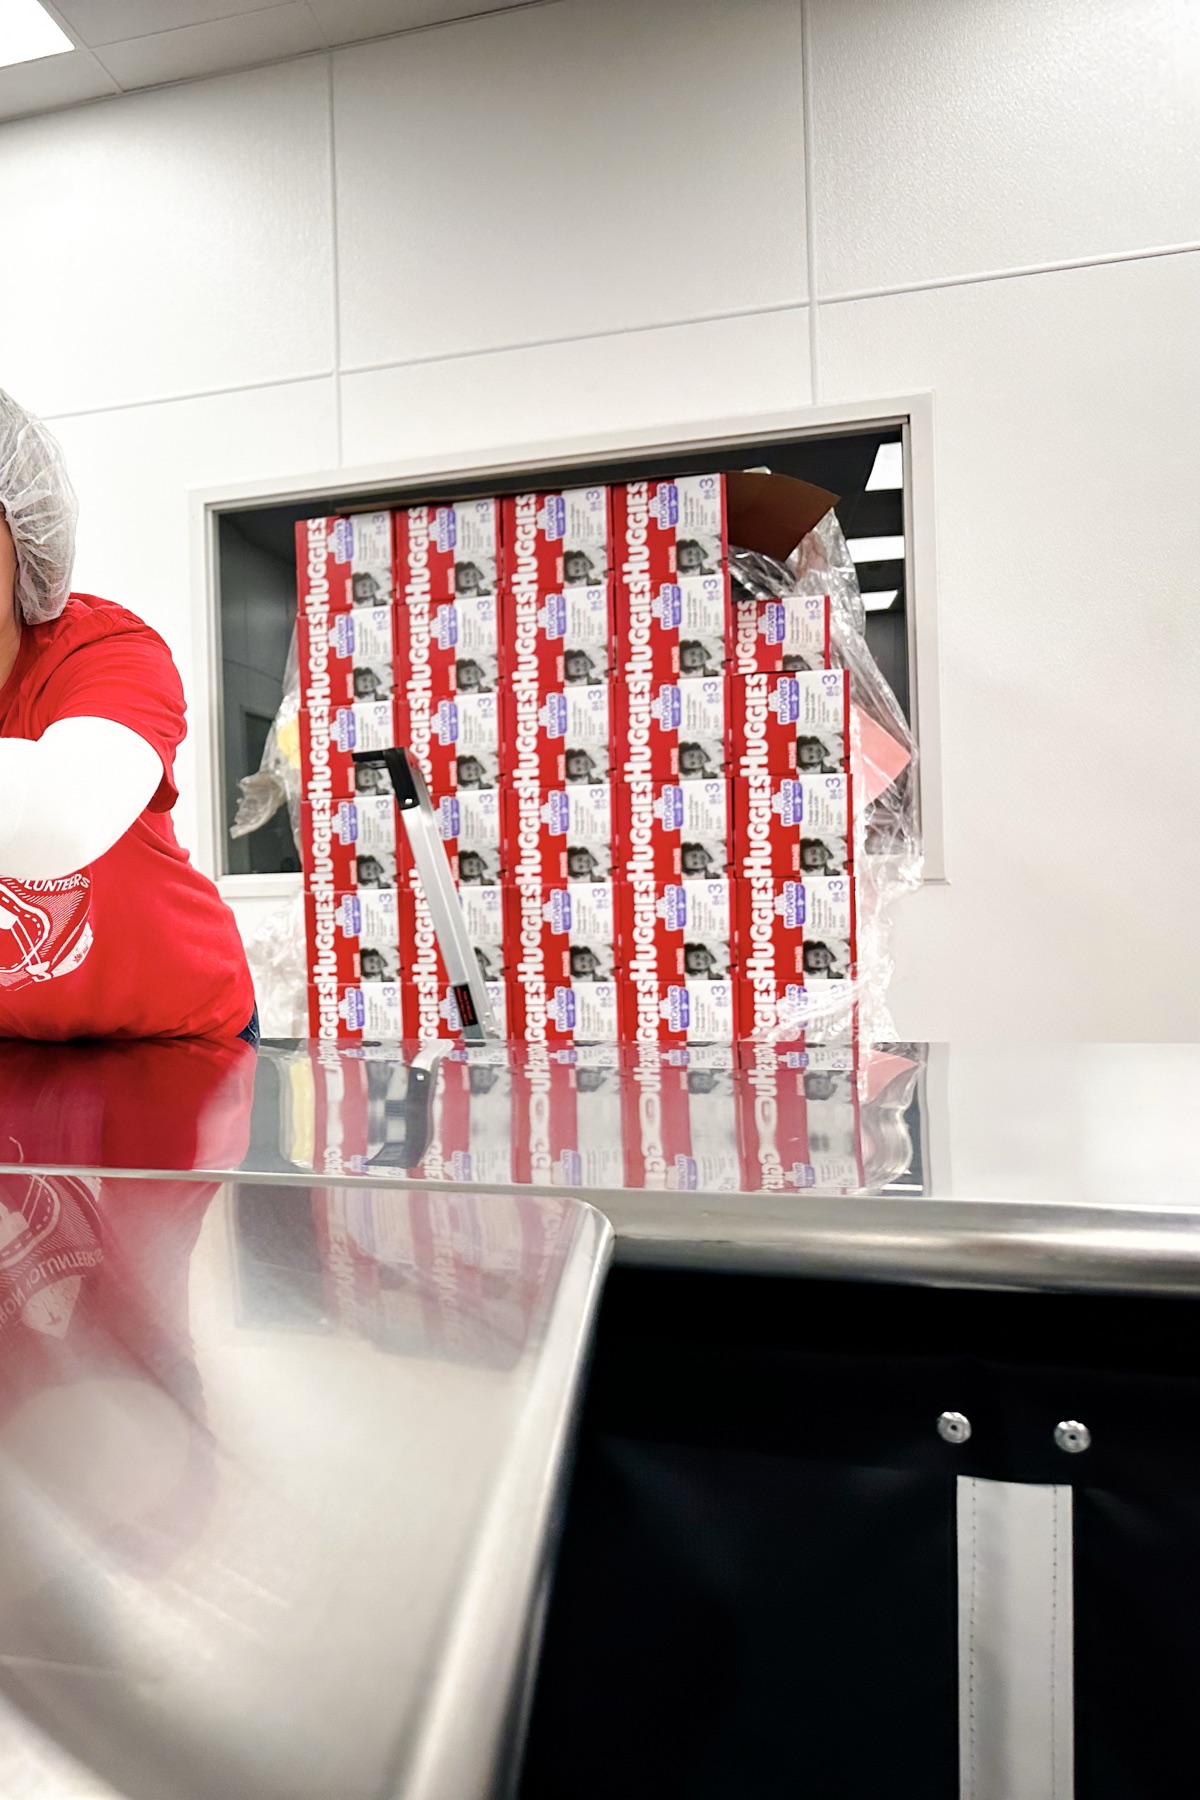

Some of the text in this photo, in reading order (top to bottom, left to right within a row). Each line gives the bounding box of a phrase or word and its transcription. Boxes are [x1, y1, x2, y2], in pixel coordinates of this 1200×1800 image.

[588, 489, 600, 499] 3
[700, 478, 714, 489] 3
[373, 514, 385, 524] 3
[476, 502, 488, 512] 3
[547, 498, 556, 539] movers
[336, 521, 345, 561] movers
[439, 510, 447, 550] movers
[511, 494, 538, 595] HUGGIES
[622, 481, 650, 585] HUGGIES
[305, 518, 330, 614] HUGGIES
[404, 507, 431, 605] HUGGIES
[587, 590, 600, 600] 3
[703, 579, 718, 590] 3
[373, 610, 386, 620] 3
[478, 600, 490, 610] 3
[548, 596, 557, 638] movers
[806, 600, 819, 610] 3
[337, 616, 345, 656] movers
[439, 606, 448, 646] movers
[512, 592, 539, 694] HUGGIES
[624, 582, 653, 684] HUGGIES
[735, 601, 758, 675] UGGIES
[306, 611, 331, 708] HUGGIES
[406, 603, 432, 701] HUGGIES
[588, 690, 601, 700] 3
[703, 682, 717, 692] 3
[822, 674, 838, 685] 3
[374, 705, 387, 714] 3
[478, 697, 491, 707] 3
[549, 694, 558, 736] movers
[663, 686, 671, 729] movers
[780, 680, 788, 722] movers
[441, 703, 449, 743] movers
[512, 690, 540, 788] HUGGIES
[624, 680, 652, 784] HUGGIES
[740, 674, 769, 777] HUGGIES
[307, 705, 333, 800] HUGGIES
[480, 793, 492, 804] 3
[590, 788, 604, 798] 3
[705, 782, 720, 793] 3
[783, 781, 791, 825] movers
[826, 778, 840, 788] 3
[376, 800, 389, 809] 3
[442, 798, 451, 838] movers
[309, 798, 334, 892] HUGGIES
[514, 786, 542, 886] HUGGIES
[626, 781, 655, 883] HUGGIES
[743, 774, 772, 878] HUGGIES
[19, 873, 91, 892] LUNTEERS
[380, 893, 392, 902] 3
[482, 890, 496, 900] 3
[593, 888, 606, 898] 3
[708, 883, 722, 894] 3
[829, 880, 843, 891] 3
[553, 891, 561, 932] movers
[786, 883, 794, 926] movers
[312, 890, 338, 984] HUGGIES
[516, 884, 544, 983] HUGGIES
[629, 880, 658, 982] HUGGIES
[746, 876, 775, 980] HUGGIES
[383, 987, 396, 996] 3
[486, 986, 499, 996] 3
[557, 988, 565, 1029] movers
[596, 986, 610, 997] 3
[670, 987, 679, 1030] movers
[711, 986, 726, 996] 3
